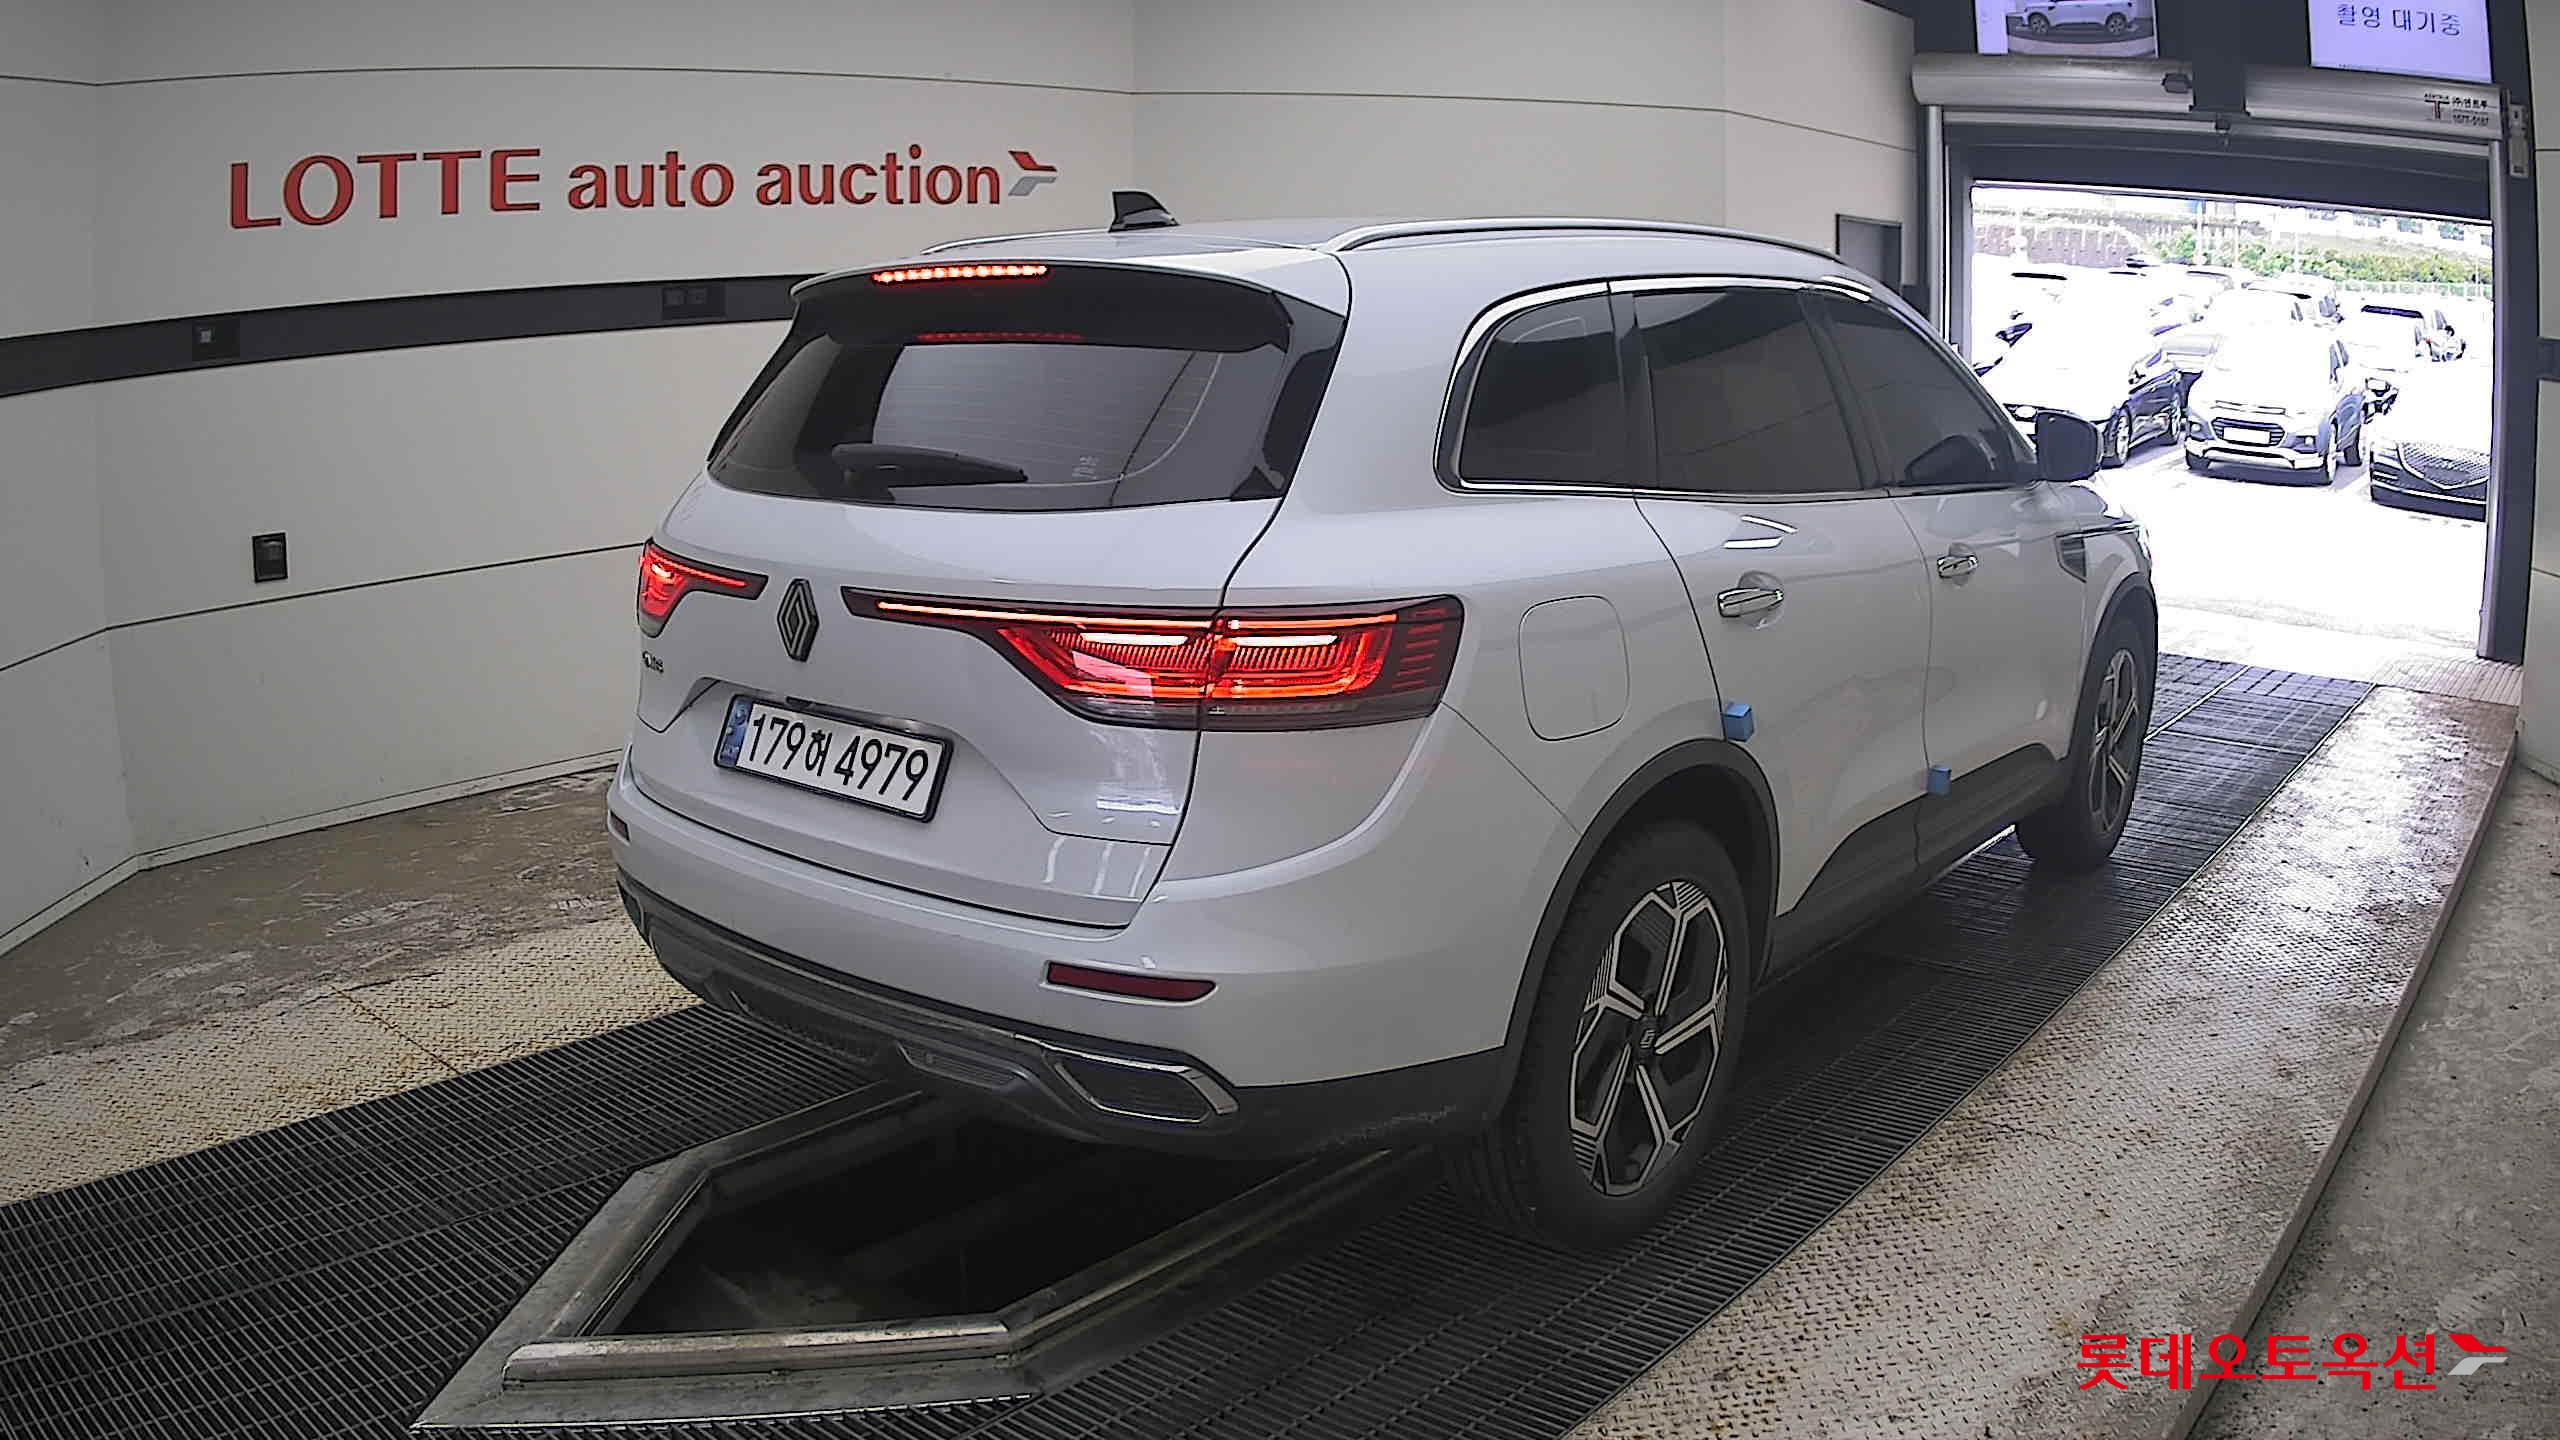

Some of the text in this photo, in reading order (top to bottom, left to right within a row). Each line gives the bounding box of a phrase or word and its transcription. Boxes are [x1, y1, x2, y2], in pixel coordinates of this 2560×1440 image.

[2337, 3, 2461, 37] 촬영 대기중
[231, 145, 1001, 230] LOTTE auto auction
[749, 713, 929, 801] 179허 4979
